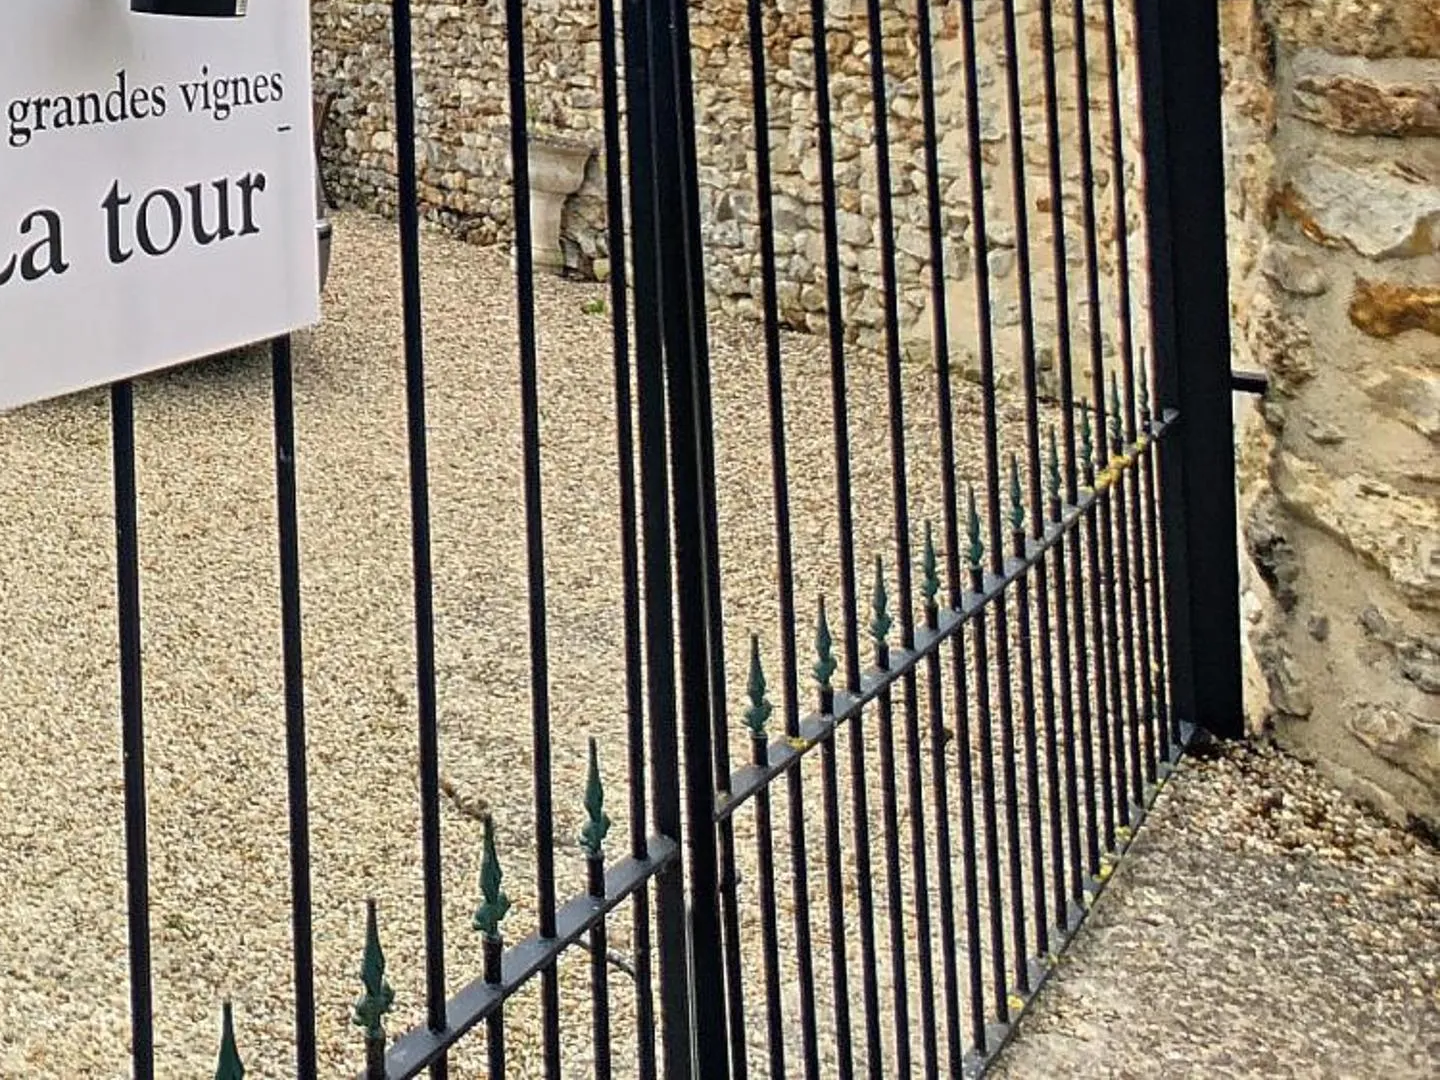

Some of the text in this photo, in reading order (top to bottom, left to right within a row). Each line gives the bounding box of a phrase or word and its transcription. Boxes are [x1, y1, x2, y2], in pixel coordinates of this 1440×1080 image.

[7, 68, 166, 148] grandes
[178, 65, 283, 121] vignes
[100, 171, 266, 265] tour
